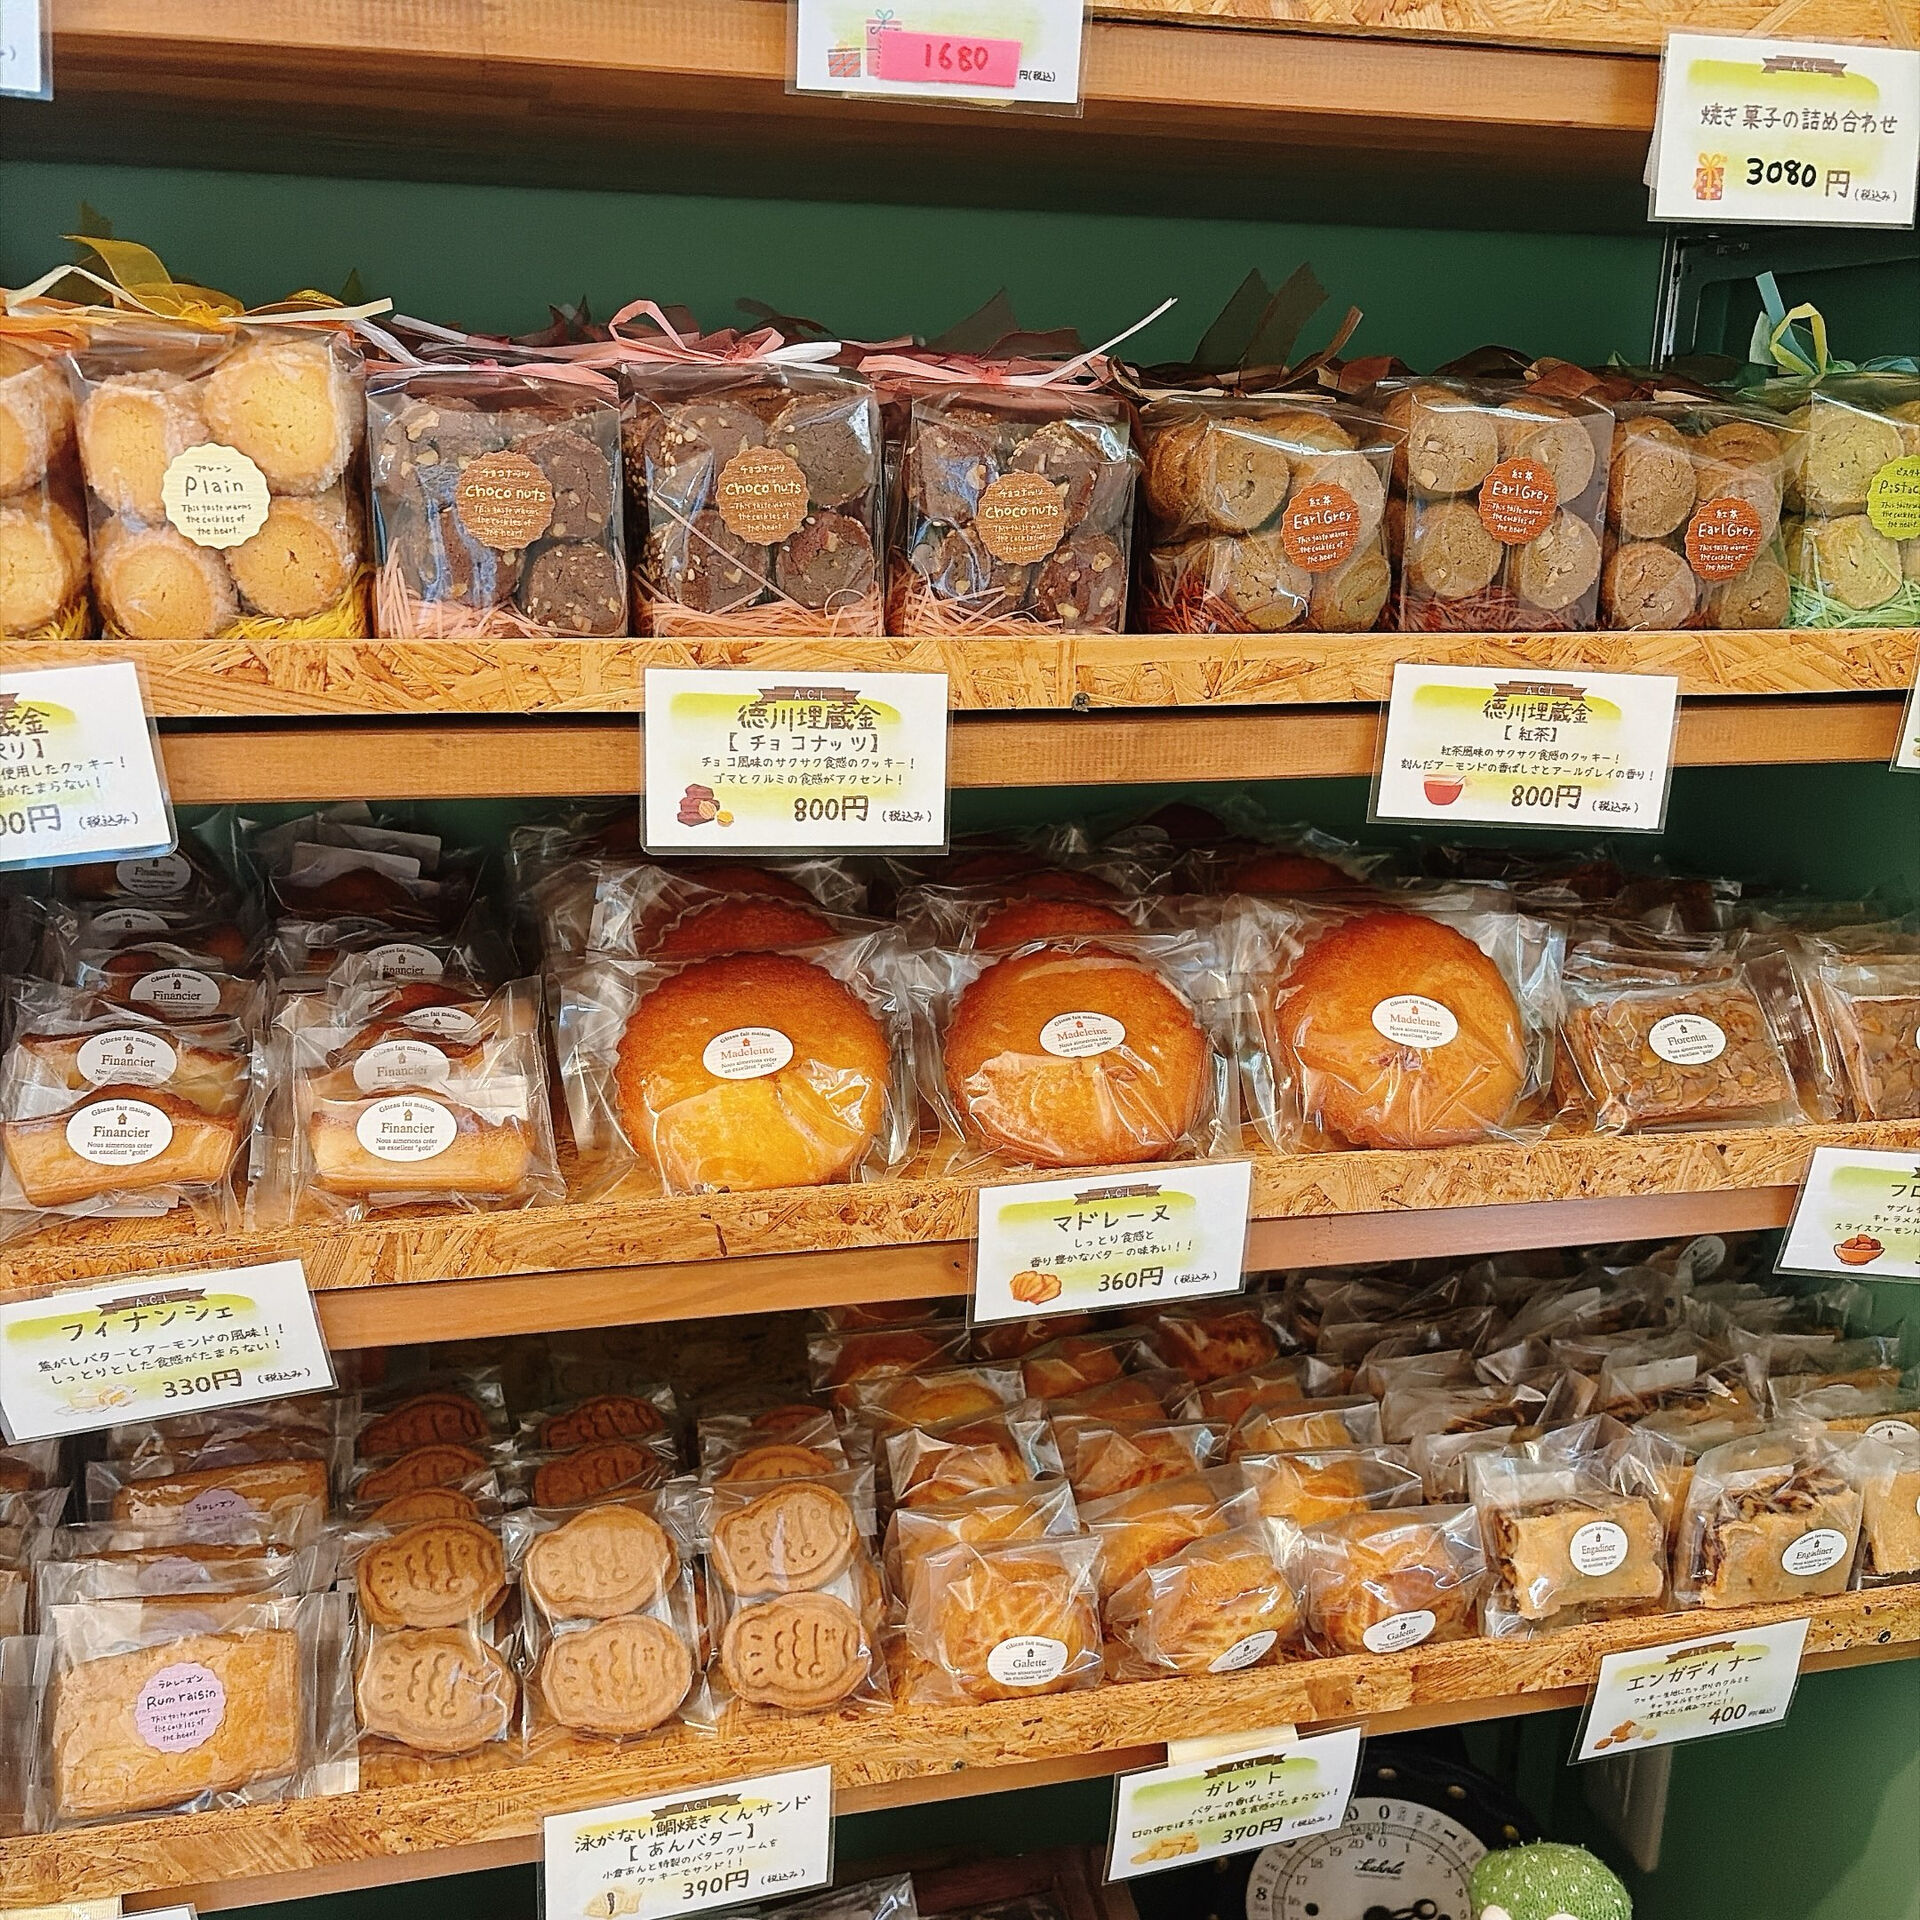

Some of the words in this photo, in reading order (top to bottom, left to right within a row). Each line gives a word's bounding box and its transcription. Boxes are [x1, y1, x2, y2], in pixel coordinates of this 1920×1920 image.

[925, 42, 989, 73] 1680
[1746, 157, 1817, 188] 3080
[1825, 169, 1851, 199] 円
[185, 475, 244, 497] Plain
[465, 484, 512, 499] Choco
[516, 487, 546, 502] nuts
[725, 482, 769, 495] Choco
[773, 480, 802, 494] nuts
[1492, 481, 1519, 496] Earl
[1521, 485, 1549, 503] Grey
[181, 504, 199, 513] This
[201, 504, 223, 513] taste
[226, 503, 252, 512] warms
[985, 506, 1028, 519] Choco
[1031, 503, 1059, 516] nuts
[186, 515, 200, 523] the
[202, 515, 235, 524] cockles
[237, 514, 245, 523] of
[1293, 511, 1321, 530] Earl
[1323, 509, 1352, 524] Grey
[197, 527, 211, 535] the
[1698, 523, 1725, 538] Earl
[1727, 522, 1755, 537] Grey
[737, 702, 881, 732] 徳川埋蔵金
[1482, 699, 1593, 724] 徳川埋蔵金
[729, 732, 880, 753] 【チョコナッツ】
[1503, 725, 1558, 743] 【紅茶】
[1511, 784, 1583, 810] 800円
[1592, 800, 1640, 813] （税込み）
[794, 795, 869, 822] 800円
[881, 810, 933, 824] （税込み）
[78, 811, 139, 830] （税込み）
[152, 990, 202, 1001] Financier
[1390, 1013, 1442, 1028] Madeleine
[1056, 1028, 1108, 1042] Madeleine
[1667, 1034, 1708, 1046] Florentin
[100, 1054, 156, 1068] Financier
[721, 1047, 776, 1060] Madeleine
[92, 1125, 151, 1138] Financier
[381, 1122, 435, 1134] Financier
[87, 1141, 104, 1149] Nous
[1053, 1204, 1171, 1233] マドレーヌ
[1075, 1231, 1154, 1249] しっとり食感と
[1098, 1266, 1164, 1292] 360円
[1174, 1271, 1217, 1285] （税込み）
[61, 1304, 234, 1342] フィナンシェ
[164, 1368, 243, 1398] 330円
[258, 1367, 311, 1384] （税込み）
[1012, 1658, 1048, 1669] Galette
[1626, 1655, 1763, 1692] エンガディナー
[146, 1696, 175, 1710] Rum
[179, 1689, 217, 1702] raisin
[1709, 1704, 1747, 1725] 400
[1206, 1771, 1282, 1797] ガレット
[1220, 1817, 1283, 1845] 370円
[630, 1822, 755, 1863] 【あんバター】
[682, 1869, 749, 1900] 390円
[1255, 1886, 1268, 1901] 8
